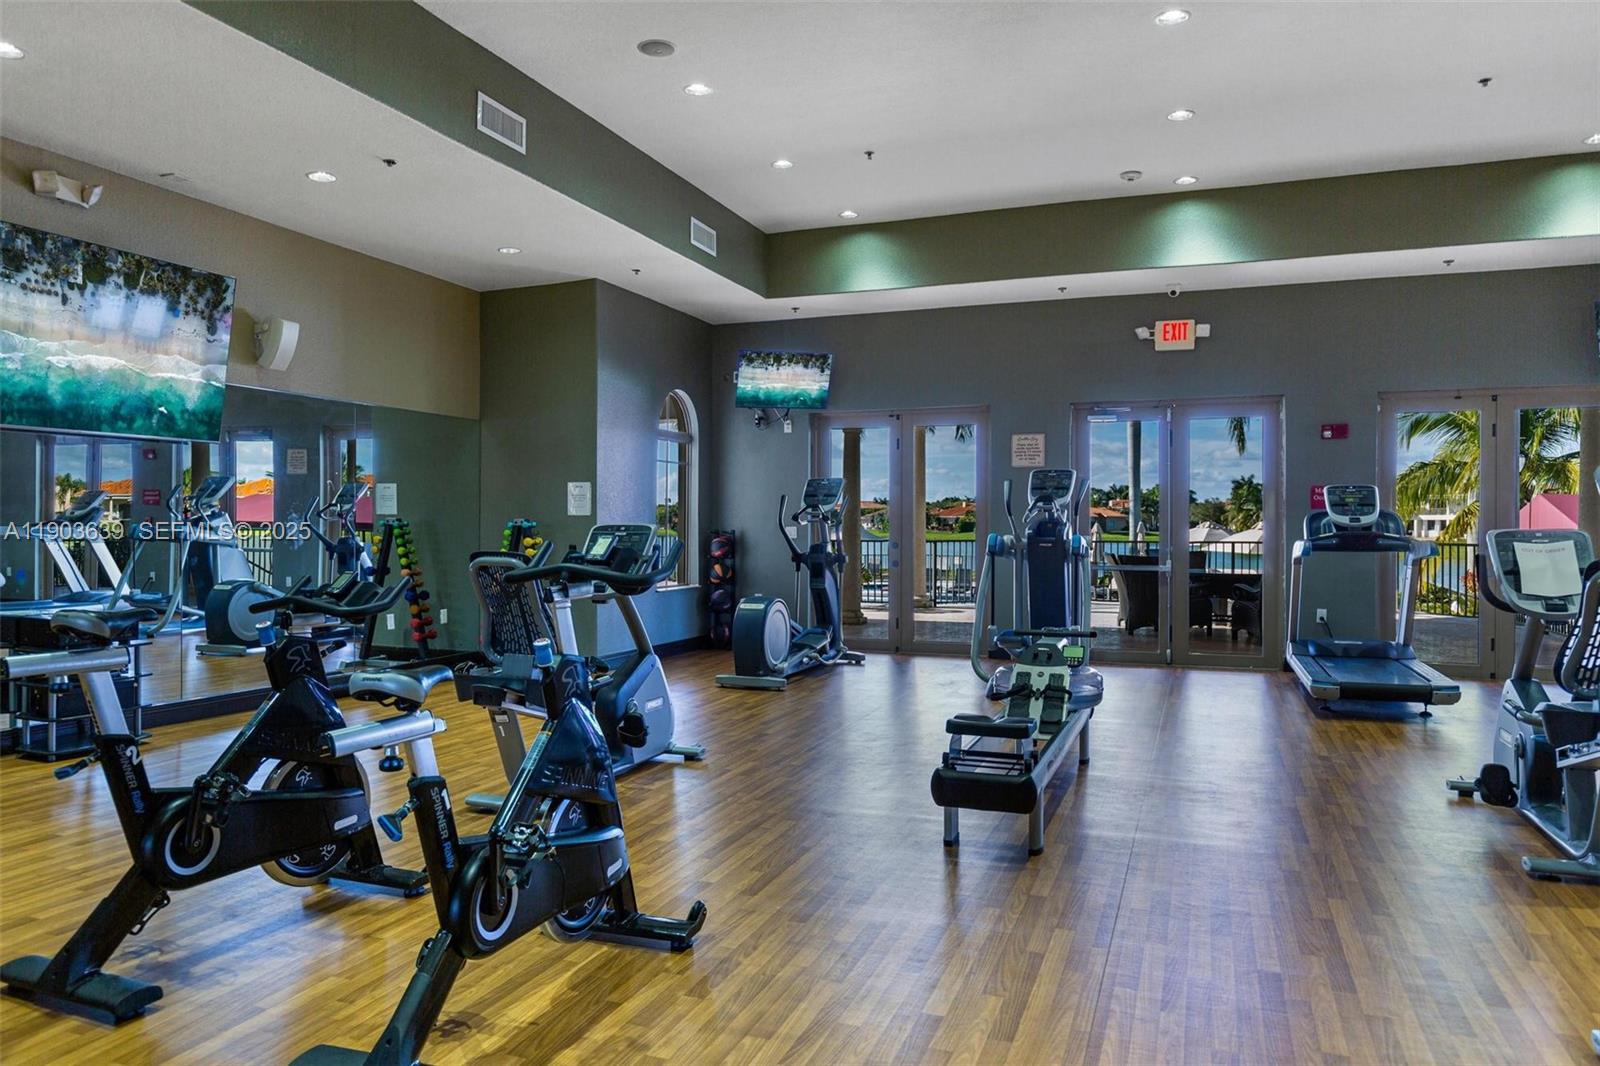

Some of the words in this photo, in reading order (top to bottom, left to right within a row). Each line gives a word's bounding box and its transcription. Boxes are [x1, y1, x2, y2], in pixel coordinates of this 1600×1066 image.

[1163, 321, 1189, 342] EXIT
[126, 745, 142, 765] 2
[441, 788, 451, 810] 1
[430, 786, 449, 839] SPINNER
